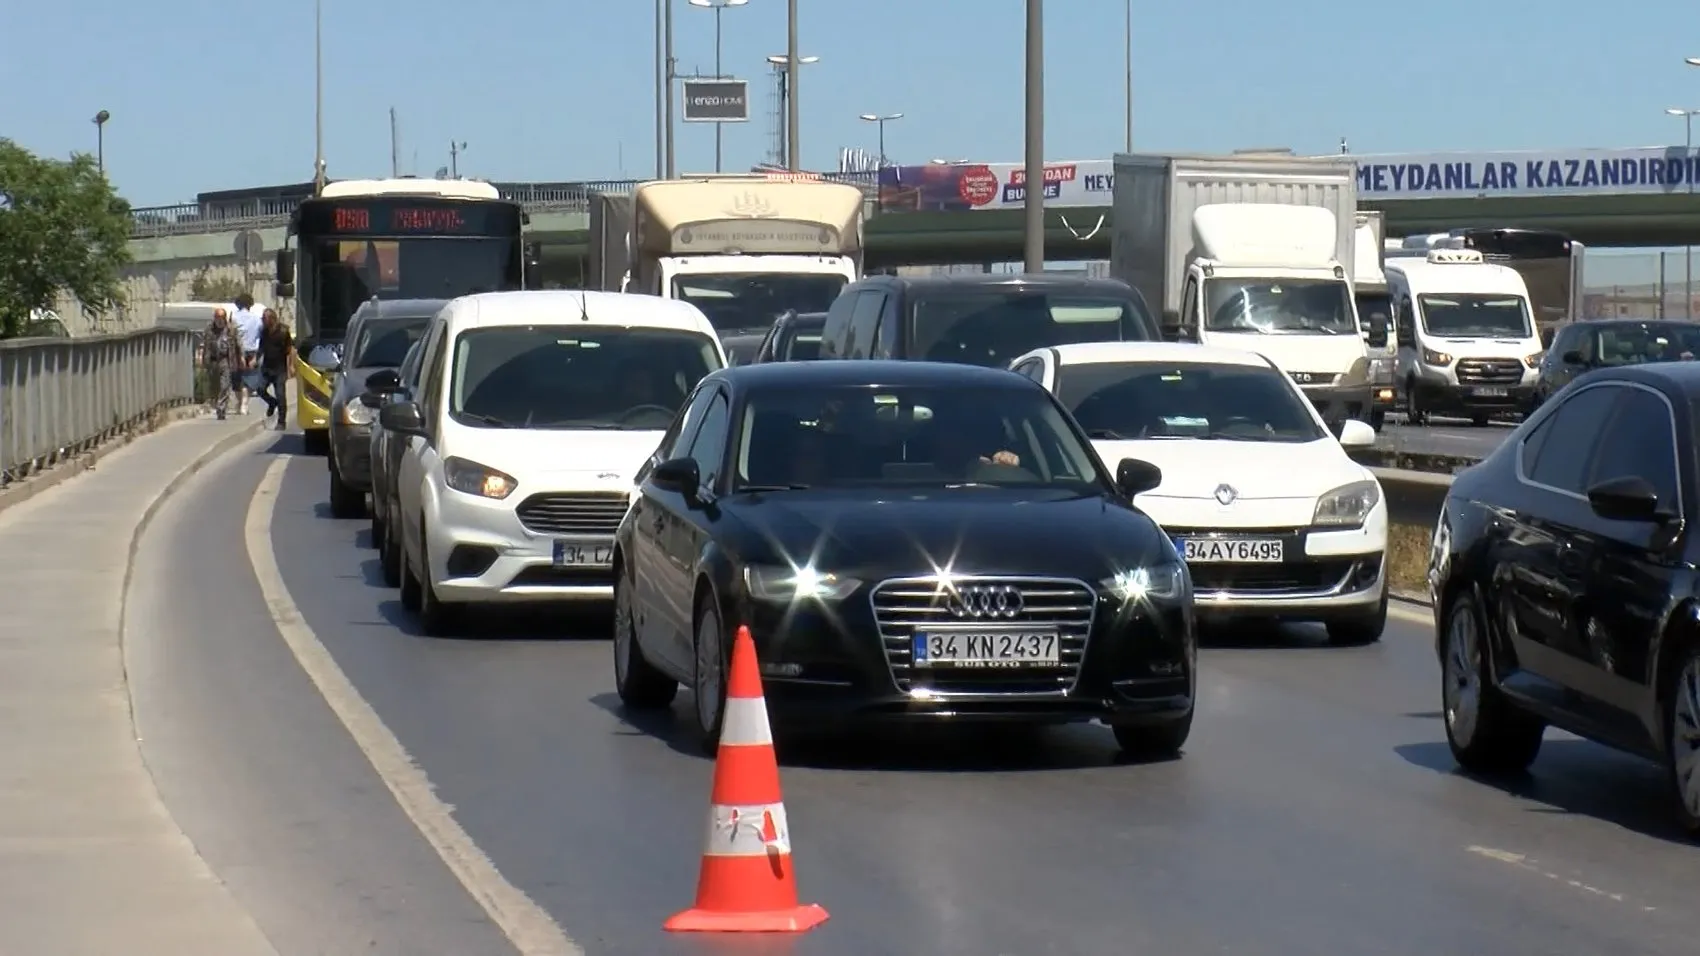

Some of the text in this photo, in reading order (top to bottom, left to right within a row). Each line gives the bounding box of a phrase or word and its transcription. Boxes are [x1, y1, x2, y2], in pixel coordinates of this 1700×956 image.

[1356, 162, 1518, 191] MEYDANLAR
[567, 546, 585, 563] 34
[930, 635, 958, 658] 34
